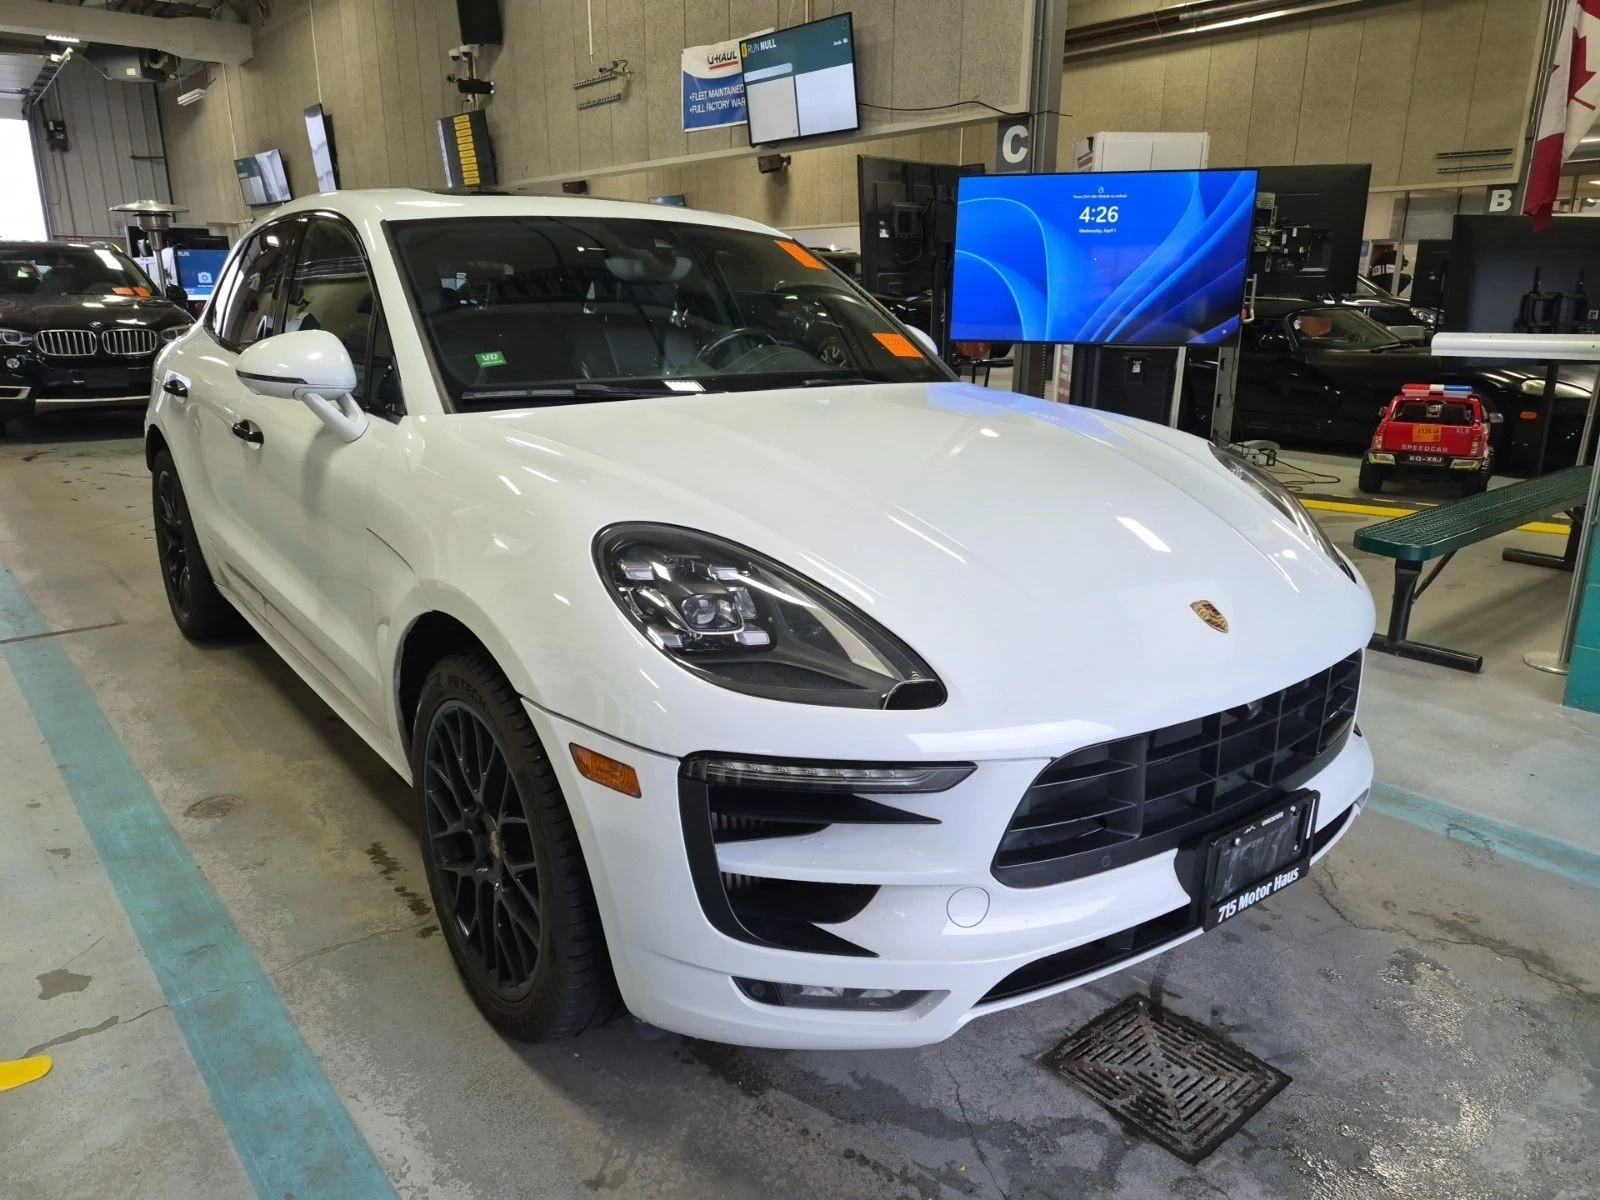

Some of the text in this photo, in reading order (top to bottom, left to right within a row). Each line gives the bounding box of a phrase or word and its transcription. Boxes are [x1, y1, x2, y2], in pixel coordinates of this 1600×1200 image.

[760, 39, 776, 50] NULL
[707, 50, 738, 65] U-HAUL
[692, 83, 744, 101] FLEET MAINTAINED
[692, 103, 705, 114] FULL
[706, 99, 730, 111] FACTORY
[1002, 124, 1029, 164] C
[1489, 189, 1512, 212] B
[1079, 205, 1119, 223] 4:26
[1401, 444, 1448, 452] SPEEDCAR
[1218, 867, 1299, 923] 715 Motor Haus
